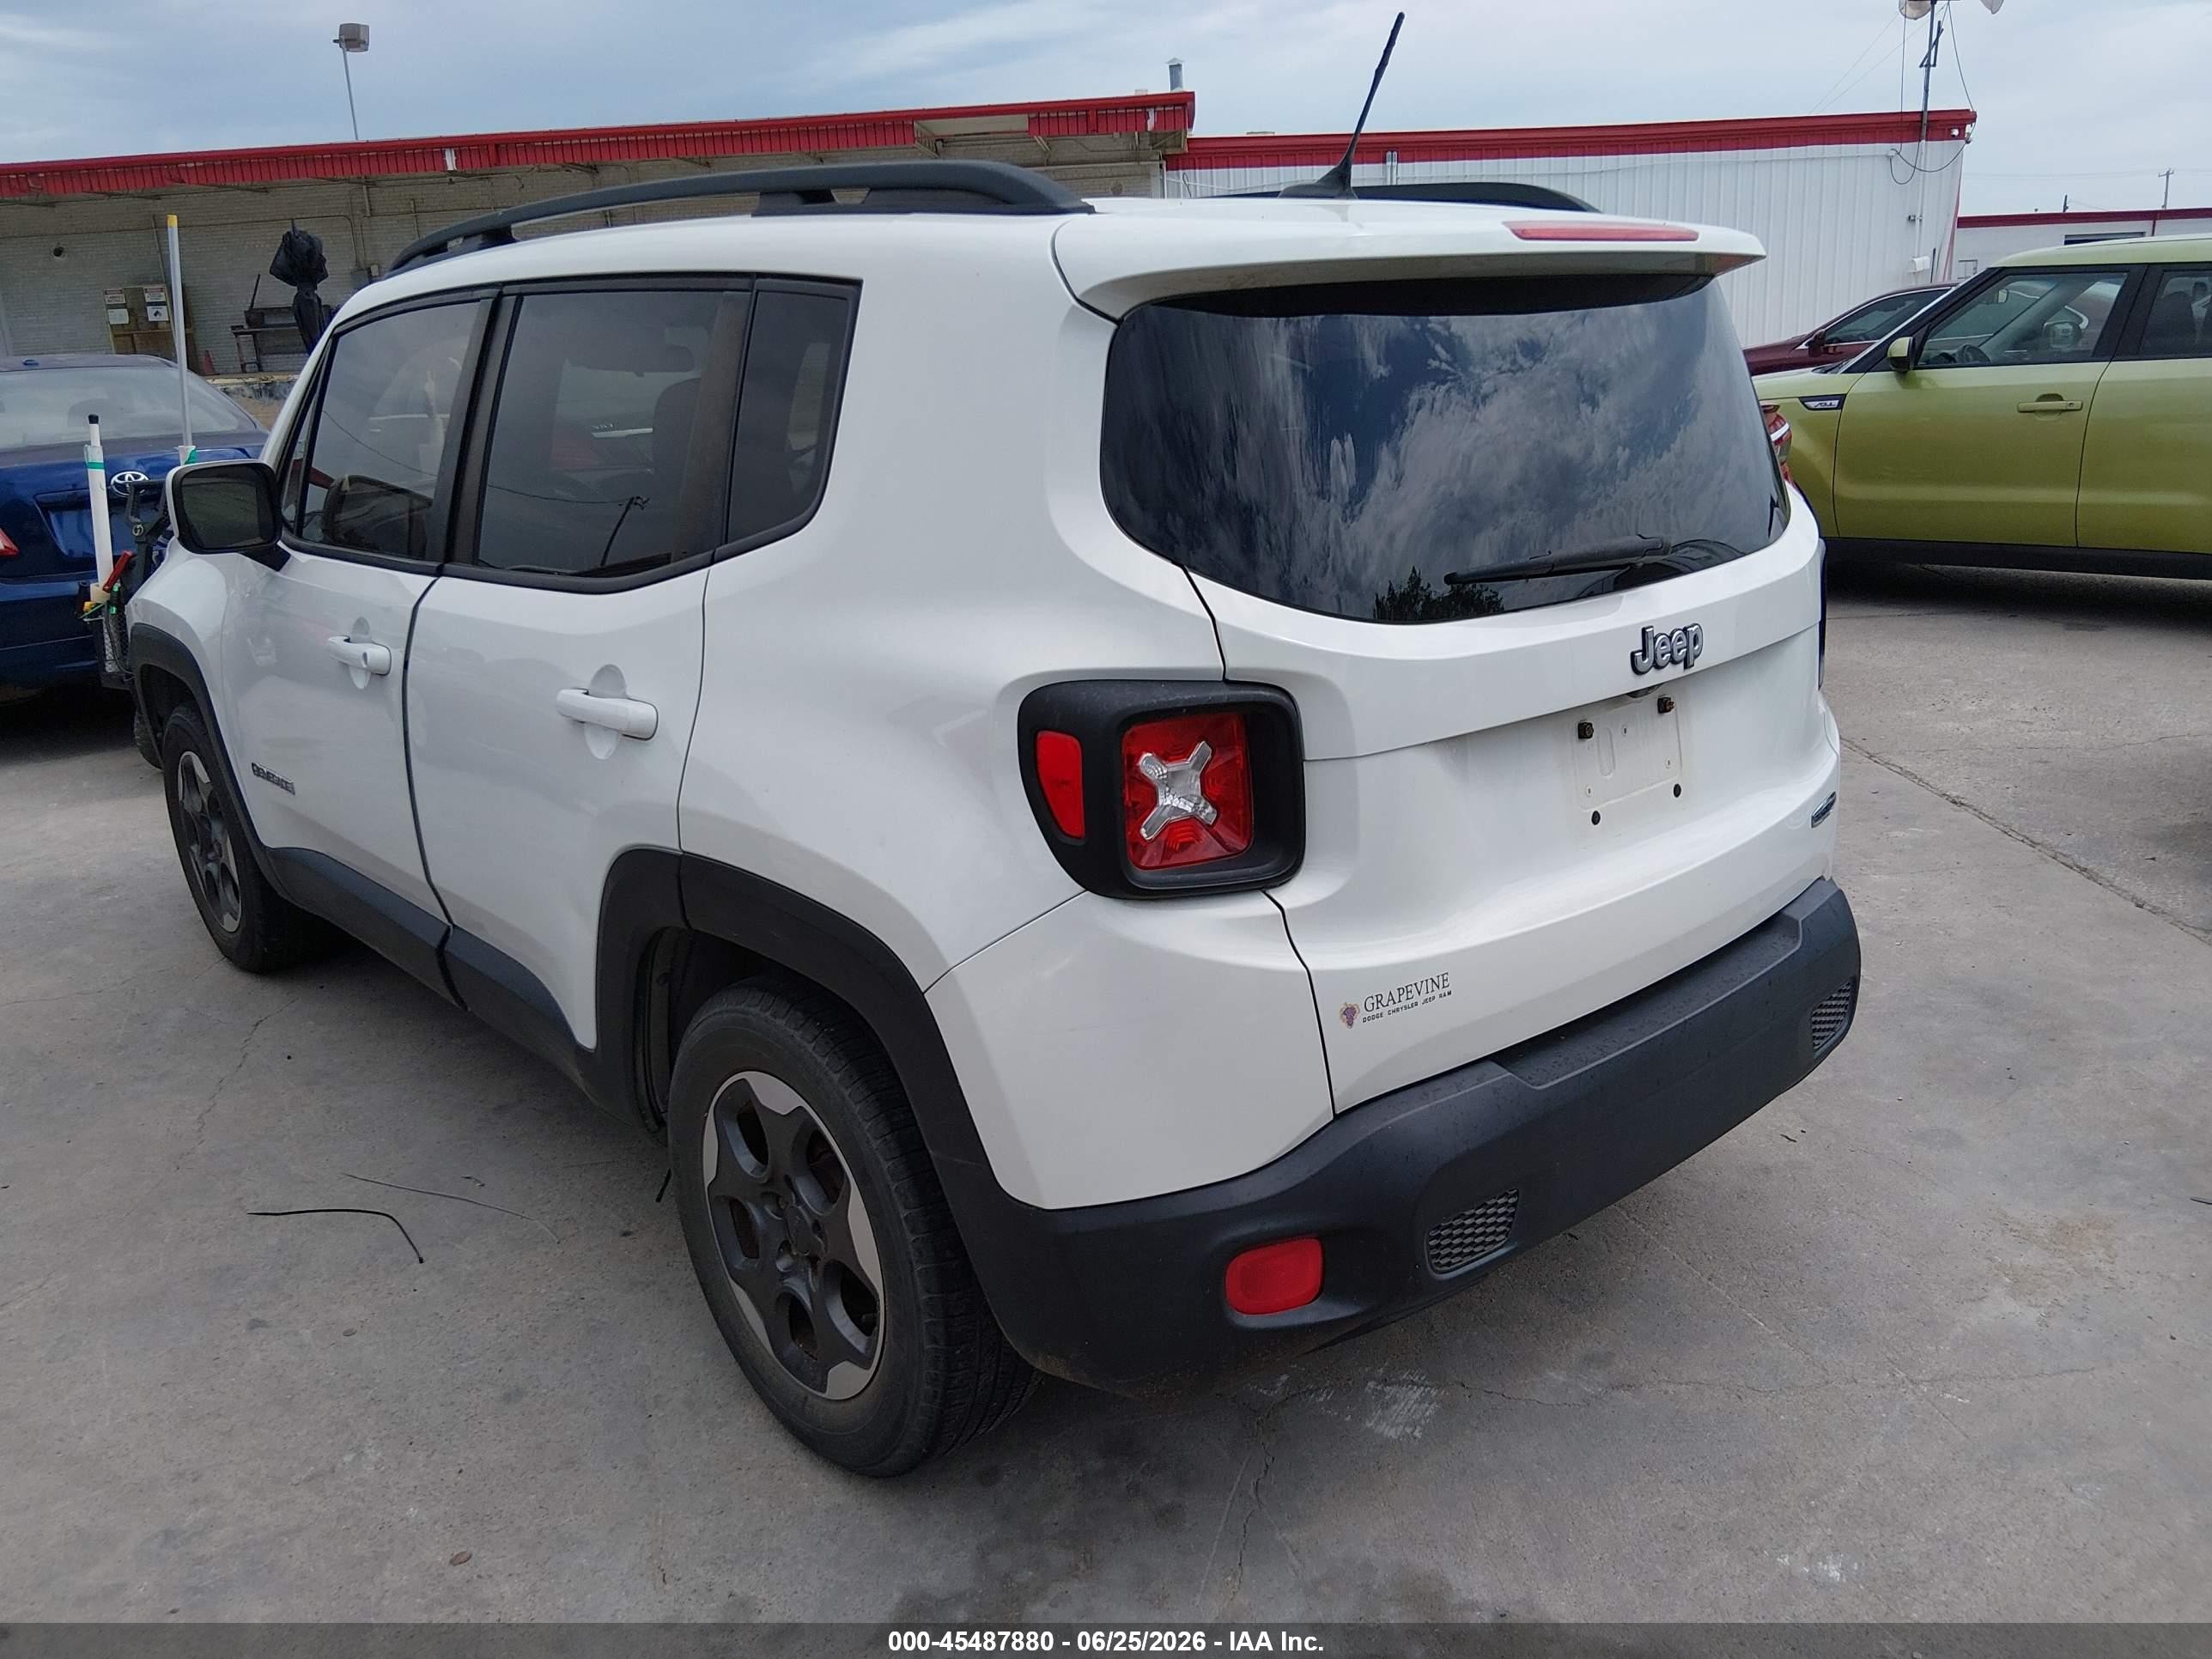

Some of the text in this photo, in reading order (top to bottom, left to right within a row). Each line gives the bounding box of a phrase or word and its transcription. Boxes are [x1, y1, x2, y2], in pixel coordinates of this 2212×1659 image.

[1630, 623, 1704, 676] Jeep
[1363, 990, 1452, 1024] DODGE CHRYSLER JEEP RAM
[1364, 972, 1450, 1012] GRAPEVINE
